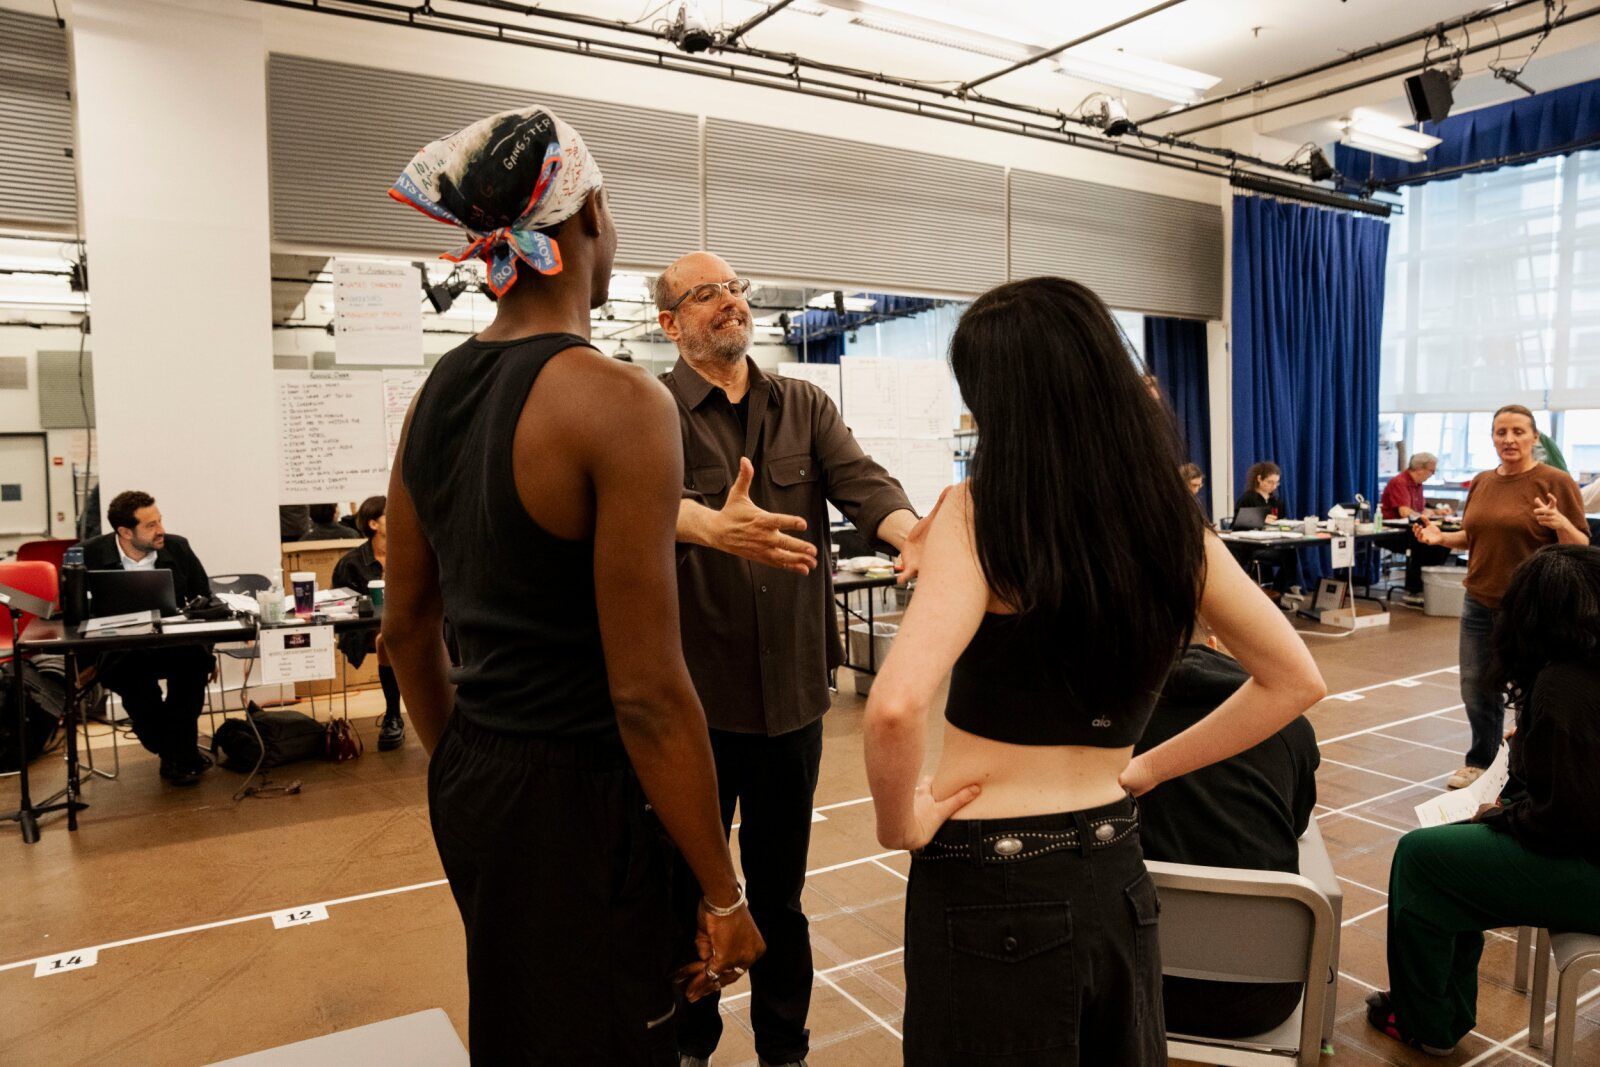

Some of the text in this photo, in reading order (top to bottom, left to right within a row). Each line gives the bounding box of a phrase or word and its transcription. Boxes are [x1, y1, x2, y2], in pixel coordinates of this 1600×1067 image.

[503, 118, 551, 170] GANGSTER
[286, 910, 315, 922] 12
[49, 955, 82, 970] 14
